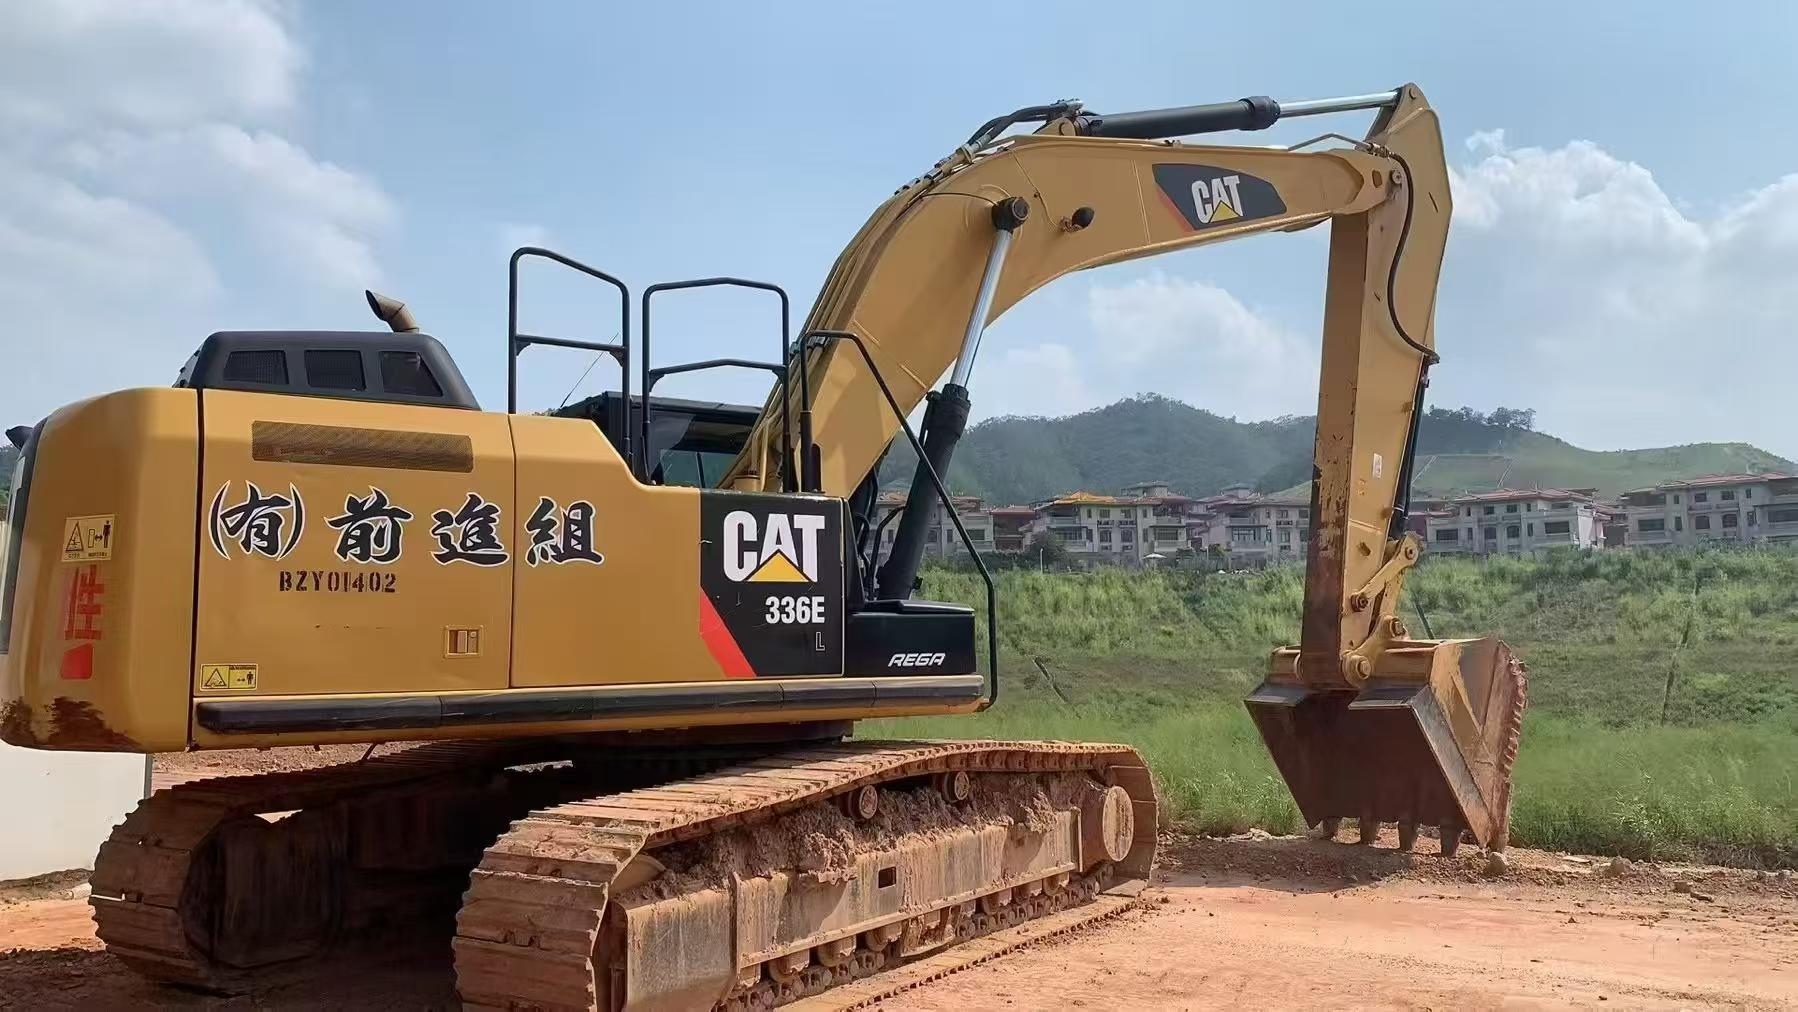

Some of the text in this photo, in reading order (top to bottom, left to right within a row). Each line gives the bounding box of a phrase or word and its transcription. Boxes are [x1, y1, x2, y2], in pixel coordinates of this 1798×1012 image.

[1191, 175, 1244, 224] CAT
[723, 510, 825, 583] CAT
[279, 570, 397, 593] BZY01402
[765, 596, 825, 624] 336E
[815, 632, 826, 651] L
[888, 652, 946, 668] REGA
